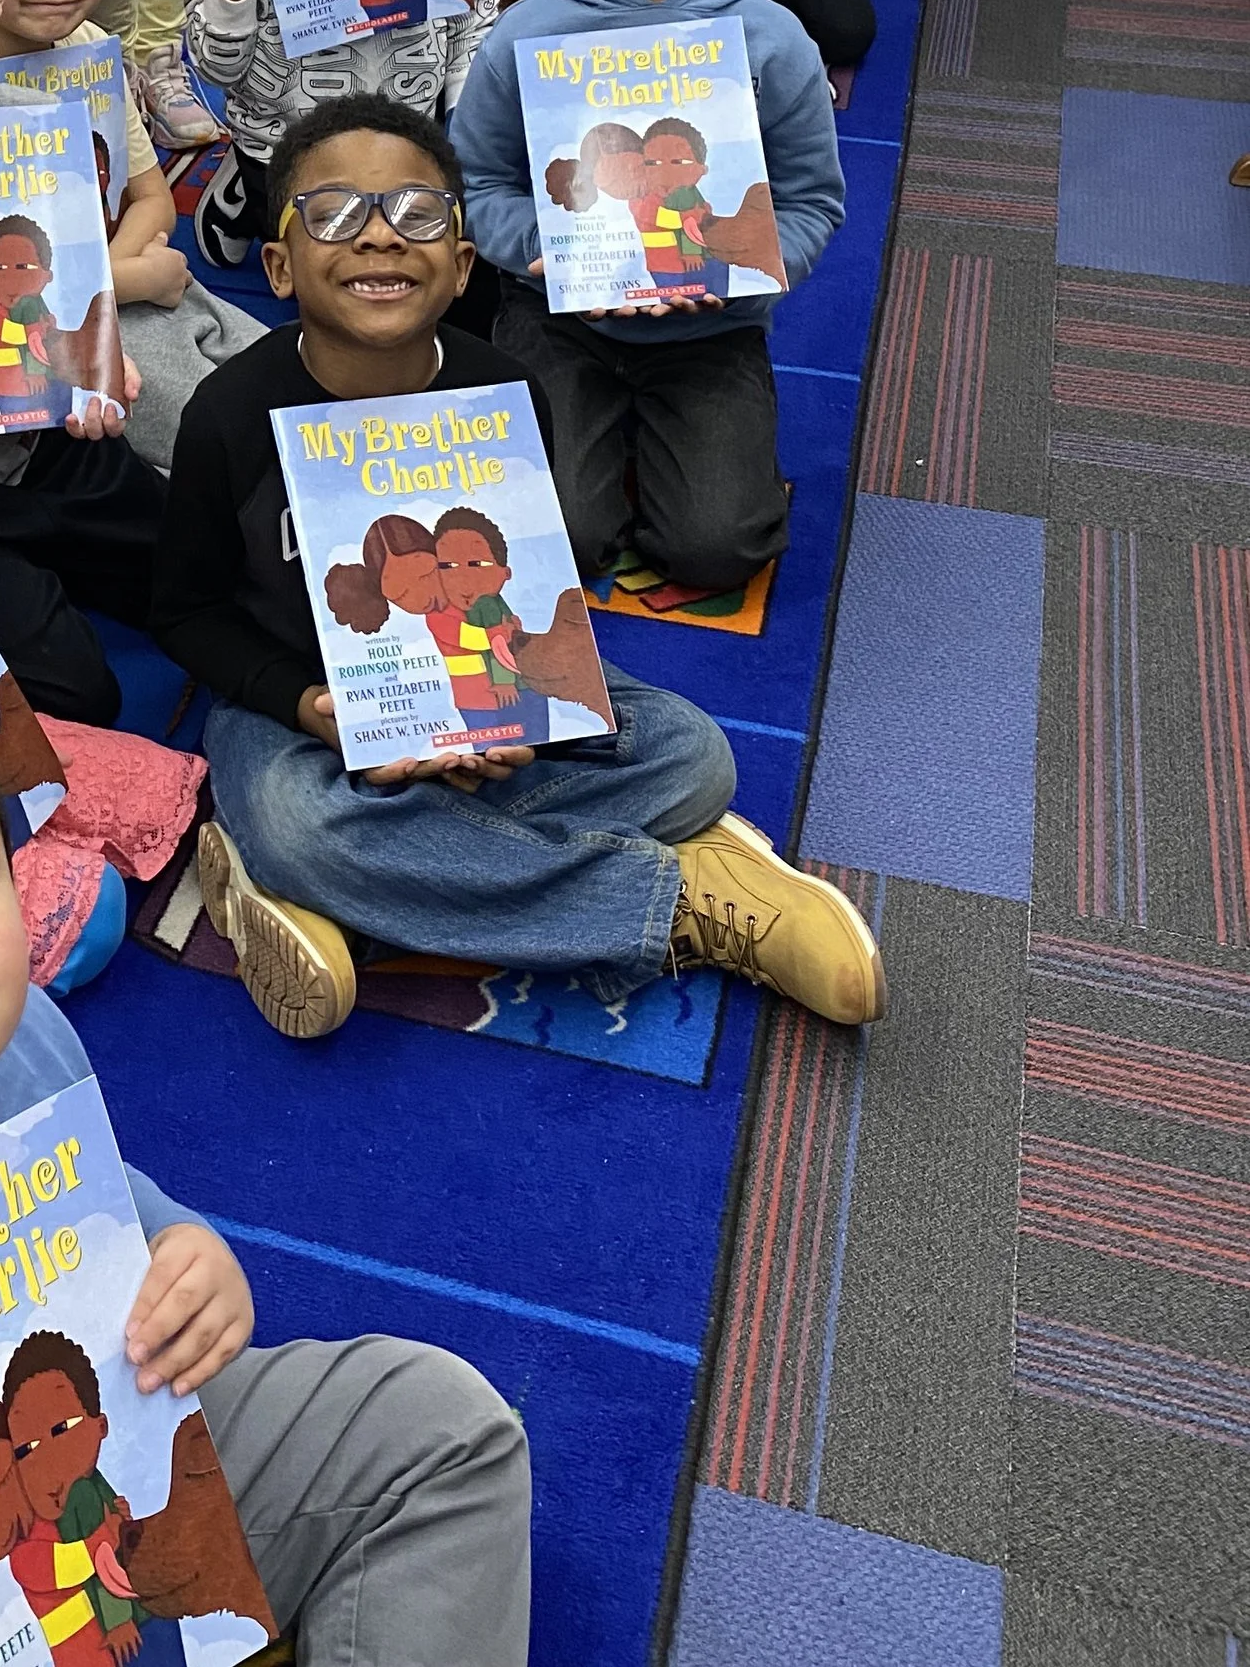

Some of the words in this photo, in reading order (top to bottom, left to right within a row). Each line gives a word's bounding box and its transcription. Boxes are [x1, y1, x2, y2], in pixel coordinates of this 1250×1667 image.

[285, 2, 305, 14] RYAN
[307, 4, 332, 18] PEETE
[290, 25, 317, 39] SHANE
[330, 15, 356, 28] EVANS
[537, 50, 584, 84] My
[591, 39, 724, 76] Brother
[46, 61, 114, 96] Brother
[586, 71, 712, 108] Charlie
[608, 279, 639, 289] EVANS
[633, 285, 702, 298] SCHOLASTIC
[299, 423, 356, 467] My
[362, 410, 512, 454] Brother
[362, 449, 506, 497] Charlie
[367, 644, 404, 660] HOLLY
[338, 660, 400, 679] ROBINSON
[402, 654, 439, 670] PEETE
[346, 688, 375, 703] RYAN
[378, 679, 441, 698] ELIZABETH
[378, 698, 415, 713] PEETE
[354, 727, 393, 743] SHANE
[396, 725, 410, 738] W.
[413, 719, 450, 735] EVANS
[443, 724, 522, 745] SCHOLASTIC
